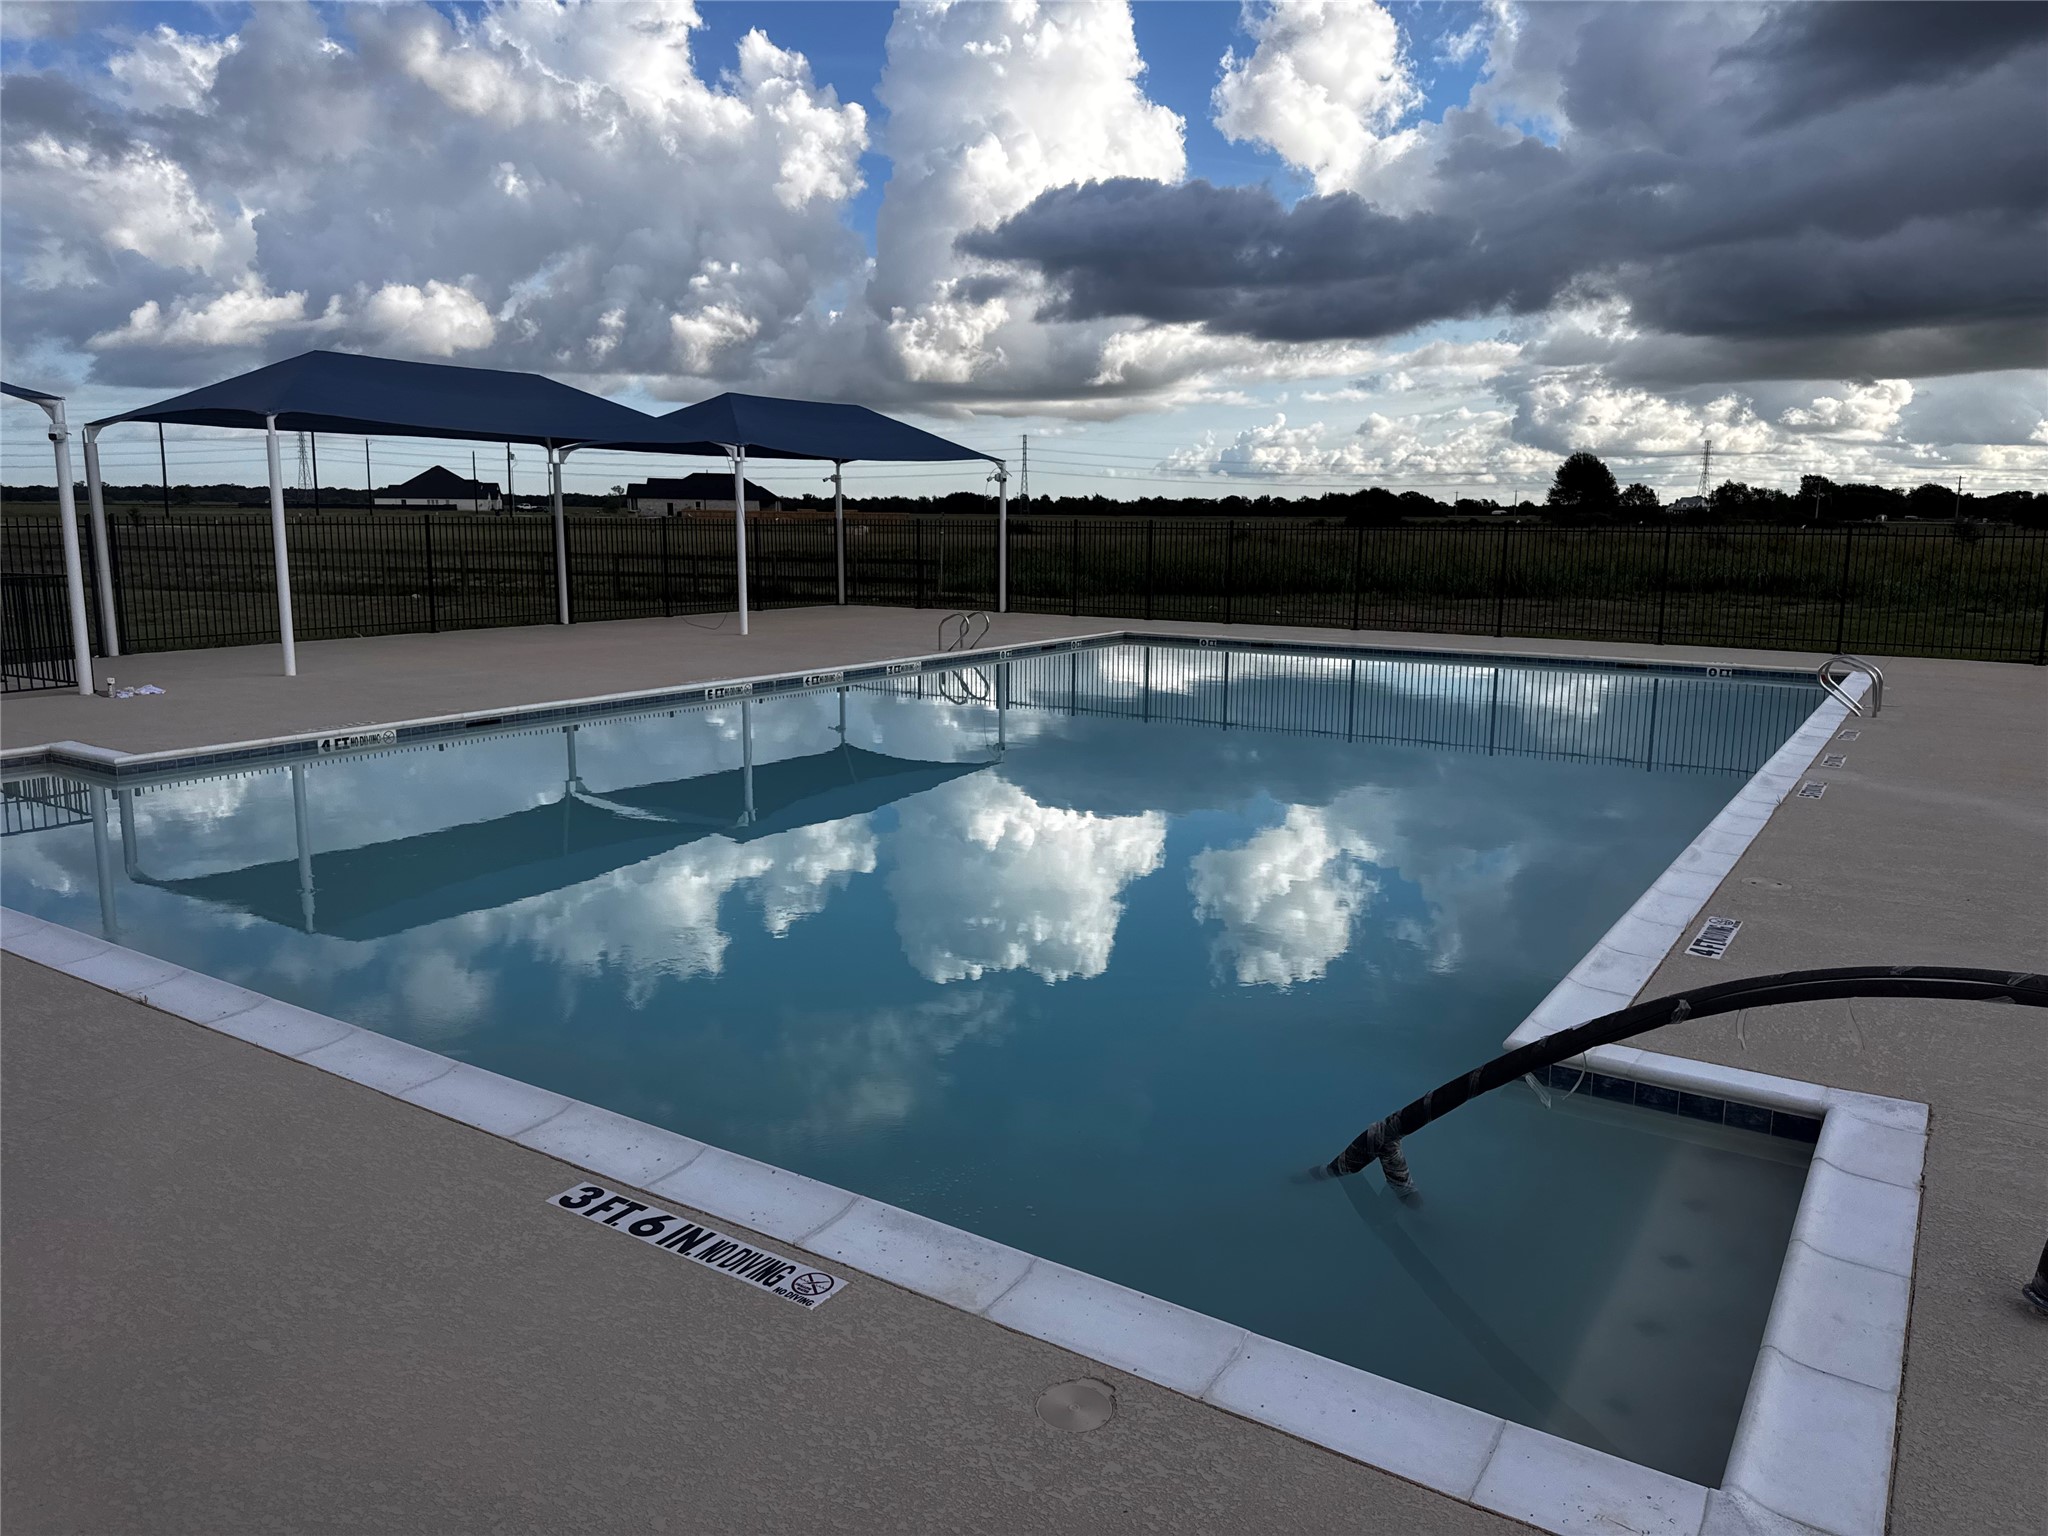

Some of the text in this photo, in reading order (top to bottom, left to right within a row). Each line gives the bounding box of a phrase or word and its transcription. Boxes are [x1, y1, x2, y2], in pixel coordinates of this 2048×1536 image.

[1689, 947, 1720, 956] 4
[1692, 938, 1727, 950] FT
[559, 1186, 797, 1287] 3 FT. 6 IN. NO DIVING
[772, 1286, 788, 1296] NO
[784, 1291, 815, 1306] DIVING
